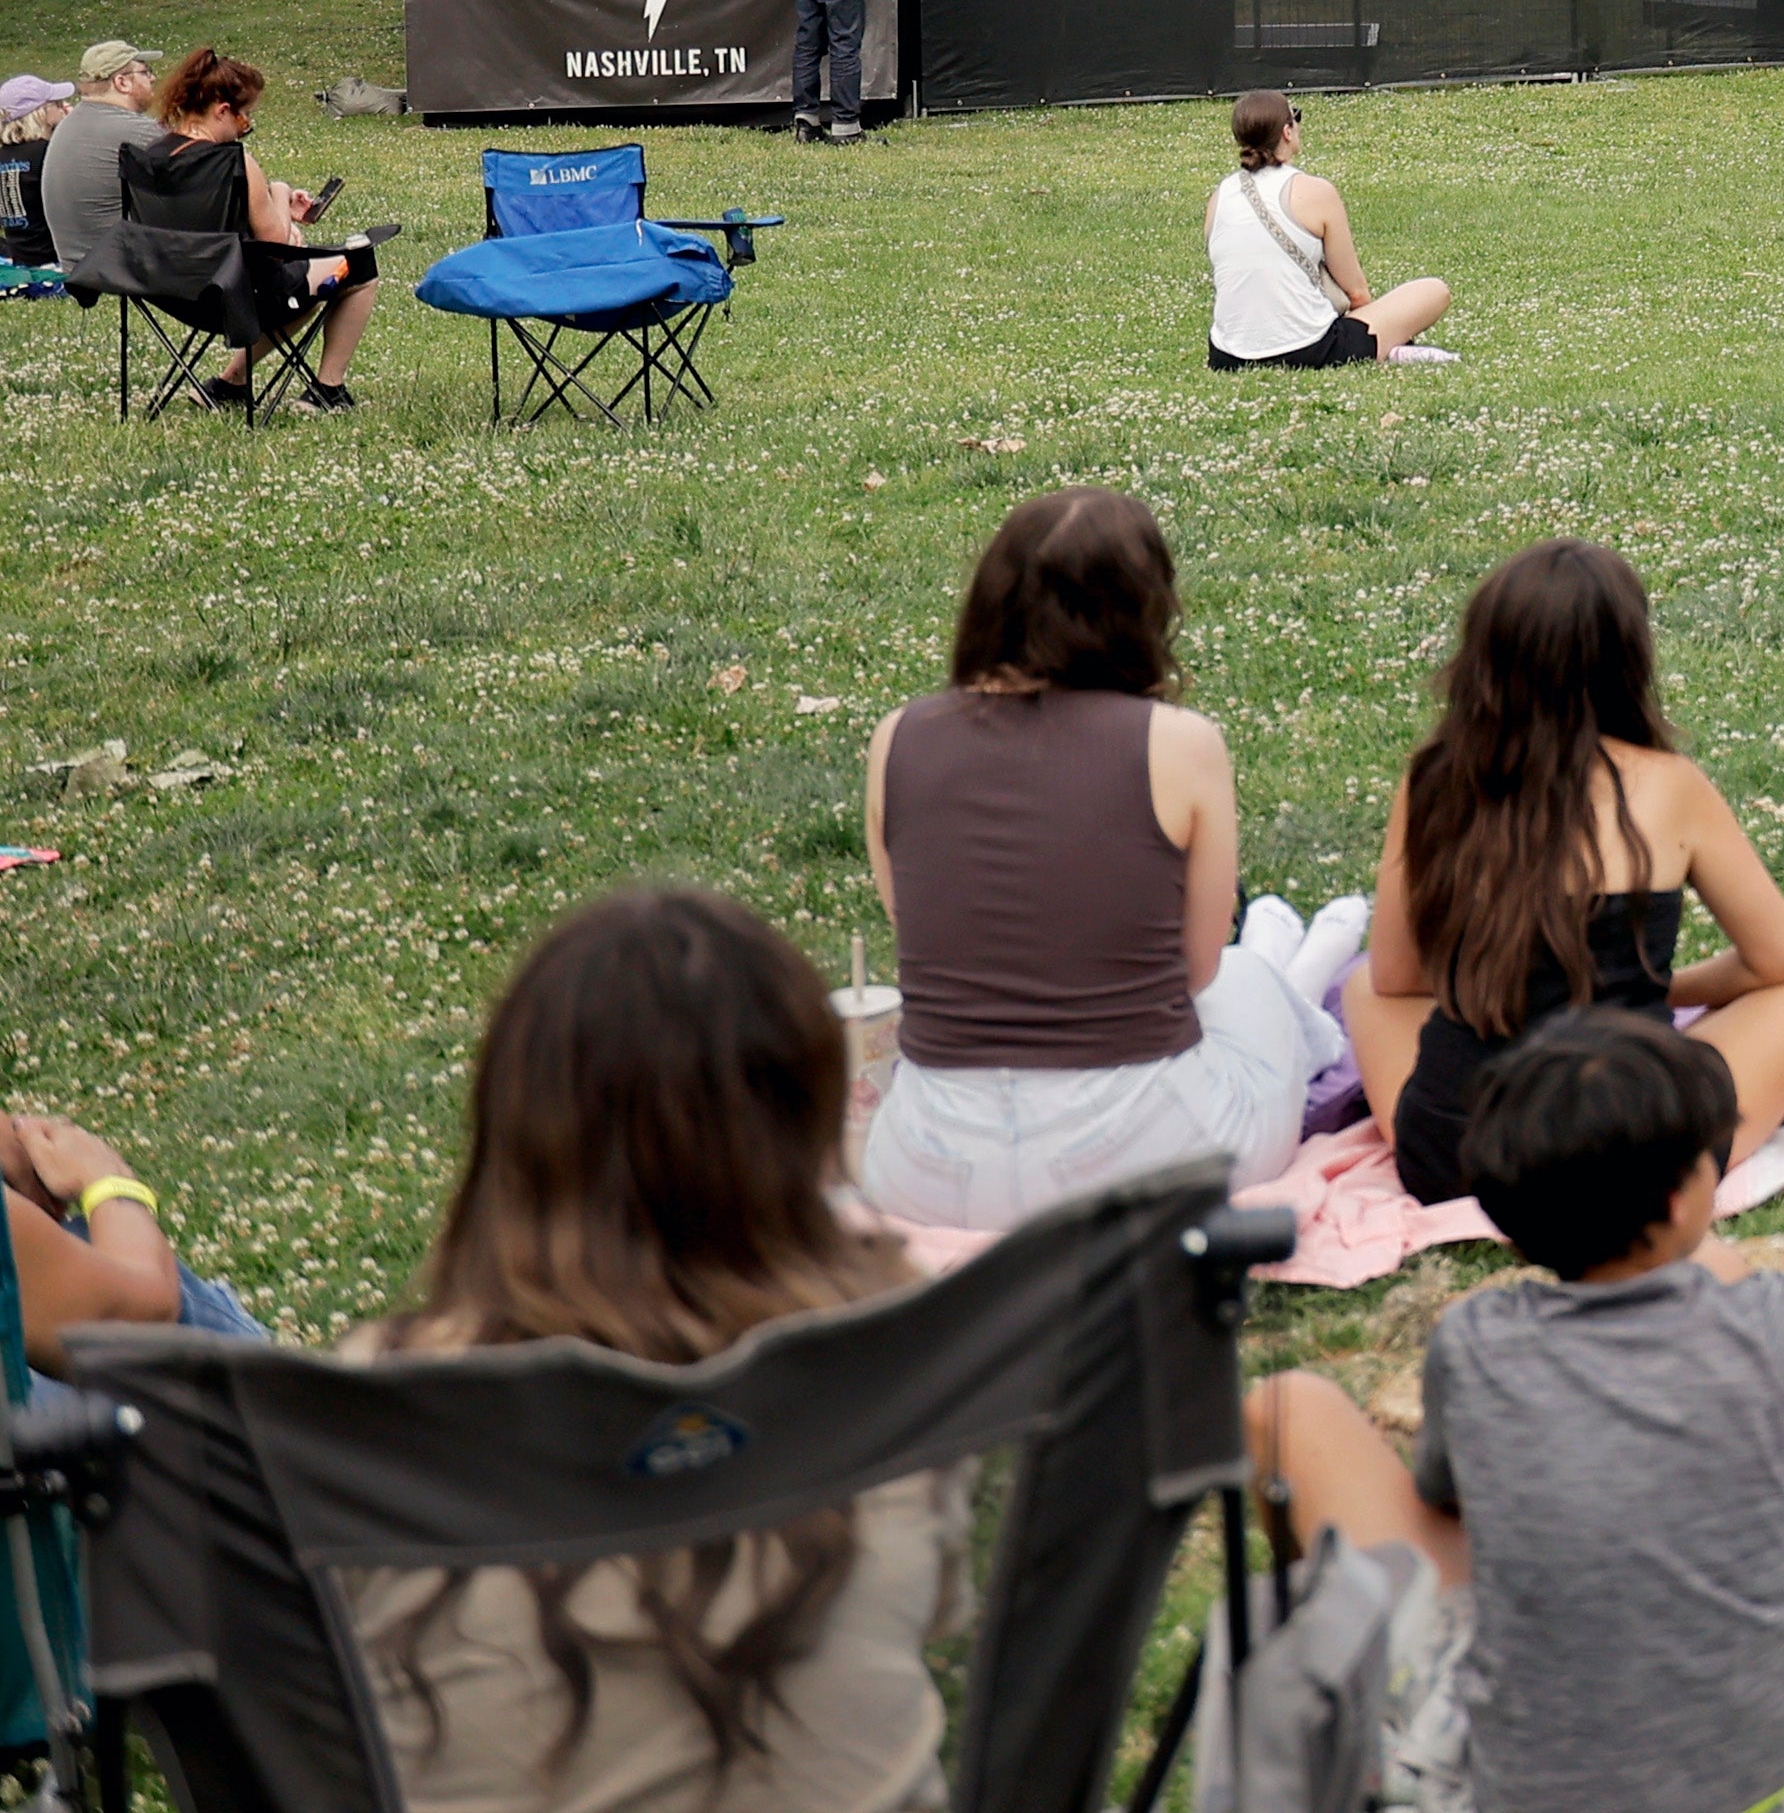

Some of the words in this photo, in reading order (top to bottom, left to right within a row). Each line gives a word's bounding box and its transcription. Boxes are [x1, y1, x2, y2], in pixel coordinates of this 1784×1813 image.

[565, 48, 710, 78] NASHVILLE,
[714, 47, 746, 74] TN
[549, 164, 598, 184] LBMC
